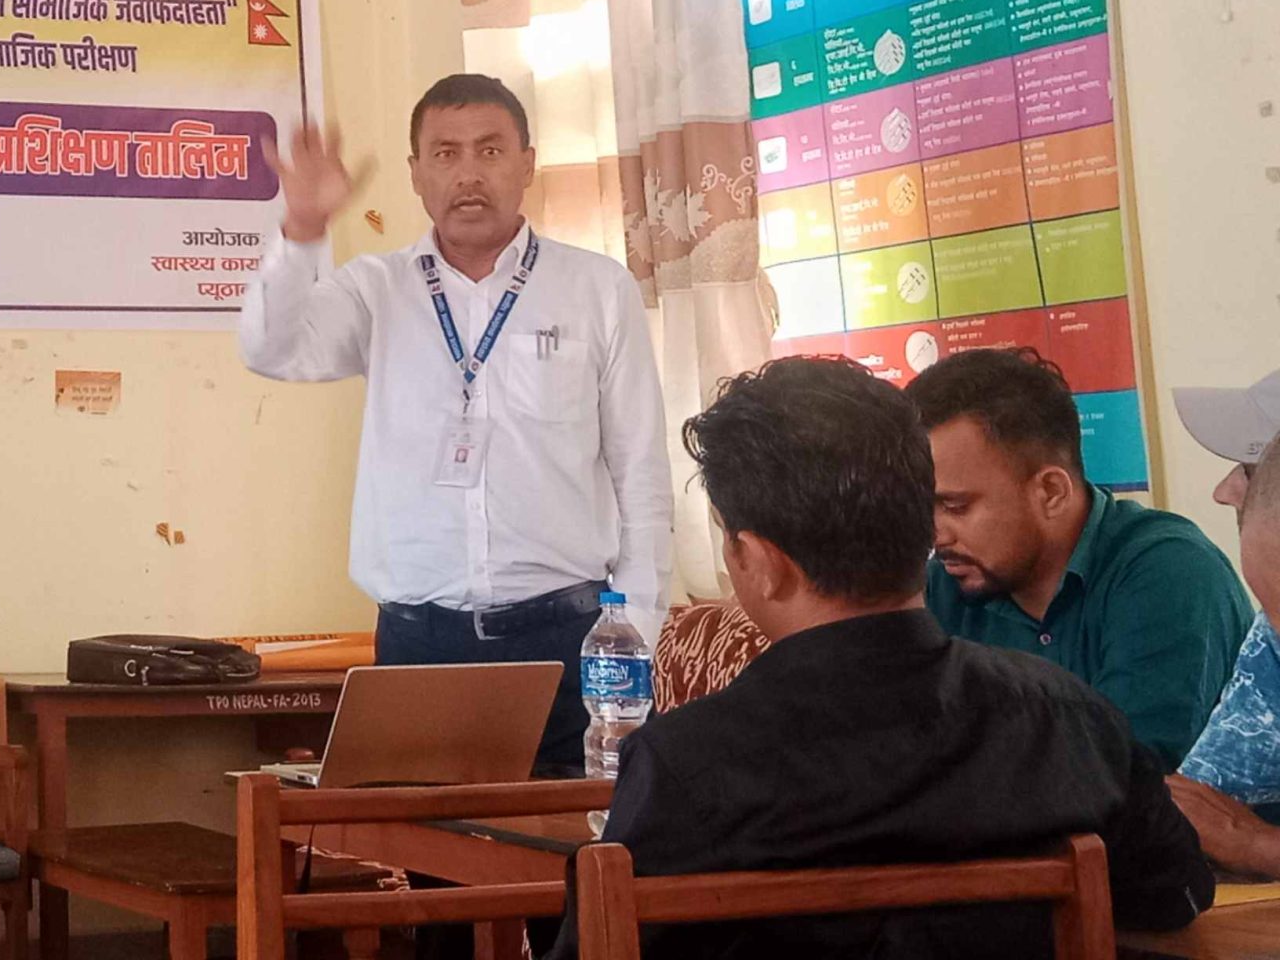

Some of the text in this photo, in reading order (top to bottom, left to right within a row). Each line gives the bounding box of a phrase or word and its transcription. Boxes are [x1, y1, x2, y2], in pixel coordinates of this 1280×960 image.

[61, 36, 138, 74] परीक्षण
[134, 119, 250, 180] तालिम
[151, 256, 215, 271] स्वास्थ्य
[206, 695, 229, 710] TPO
